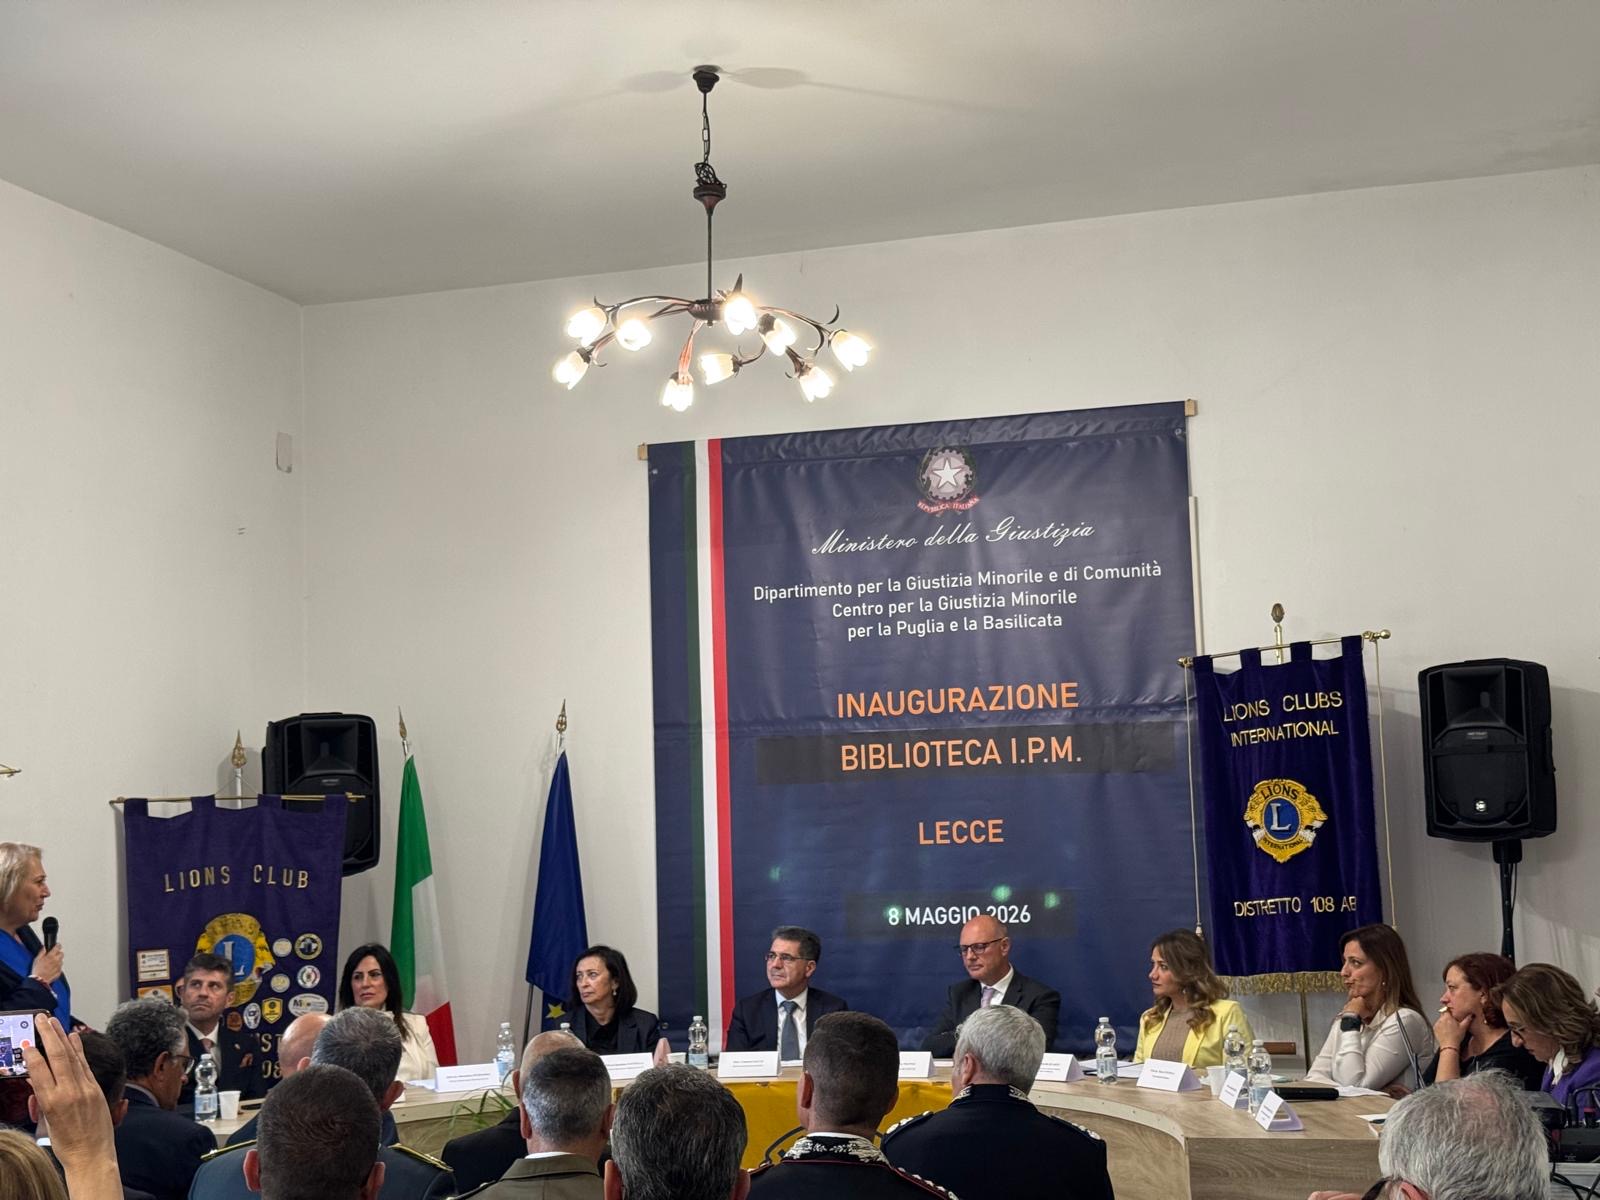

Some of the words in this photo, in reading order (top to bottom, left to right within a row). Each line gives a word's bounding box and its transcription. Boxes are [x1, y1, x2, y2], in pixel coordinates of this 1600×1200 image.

[812, 528, 917, 555] Ministero
[923, 522, 979, 546] della
[985, 515, 1095, 547] Giustizia
[754, 582, 852, 603] Dipartimento
[857, 582, 883, 597] per
[888, 578, 901, 592] la
[906, 573, 972, 590] Giustizia
[978, 569, 1043, 586] Minorile
[1049, 571, 1058, 582] e
[1064, 566, 1078, 581] di
[1083, 560, 1162, 580] Comunità
[832, 602, 883, 617] Centro
[888, 601, 914, 617] per
[919, 598, 932, 612] la
[938, 594, 1006, 611] Giustizia
[1011, 589, 1077, 607] Minorile
[848, 625, 873, 641] per
[878, 622, 891, 636] la
[897, 619, 945, 638] Puglia
[950, 621, 959, 632] e
[964, 617, 977, 631] la
[983, 614, 1063, 630] Basilicata
[838, 682, 1079, 718] INAUGURAZIONE
[1223, 699, 1270, 722] LIONS
[1282, 691, 1343, 712] CLUBS
[1230, 720, 1339, 747] INTERNATIONAL
[841, 738, 1002, 771] BIBLIOTECA
[1011, 735, 1082, 764] I.P.M.
[1261, 783, 1300, 800] LIONS
[1269, 803, 1292, 831] L
[918, 819, 1004, 845] LECCE
[165, 866, 231, 892] LIONS
[253, 864, 309, 889] CLUB
[888, 907, 899, 926] 8
[1234, 896, 1301, 917] DISTRETTO
[1310, 896, 1335, 913] 108
